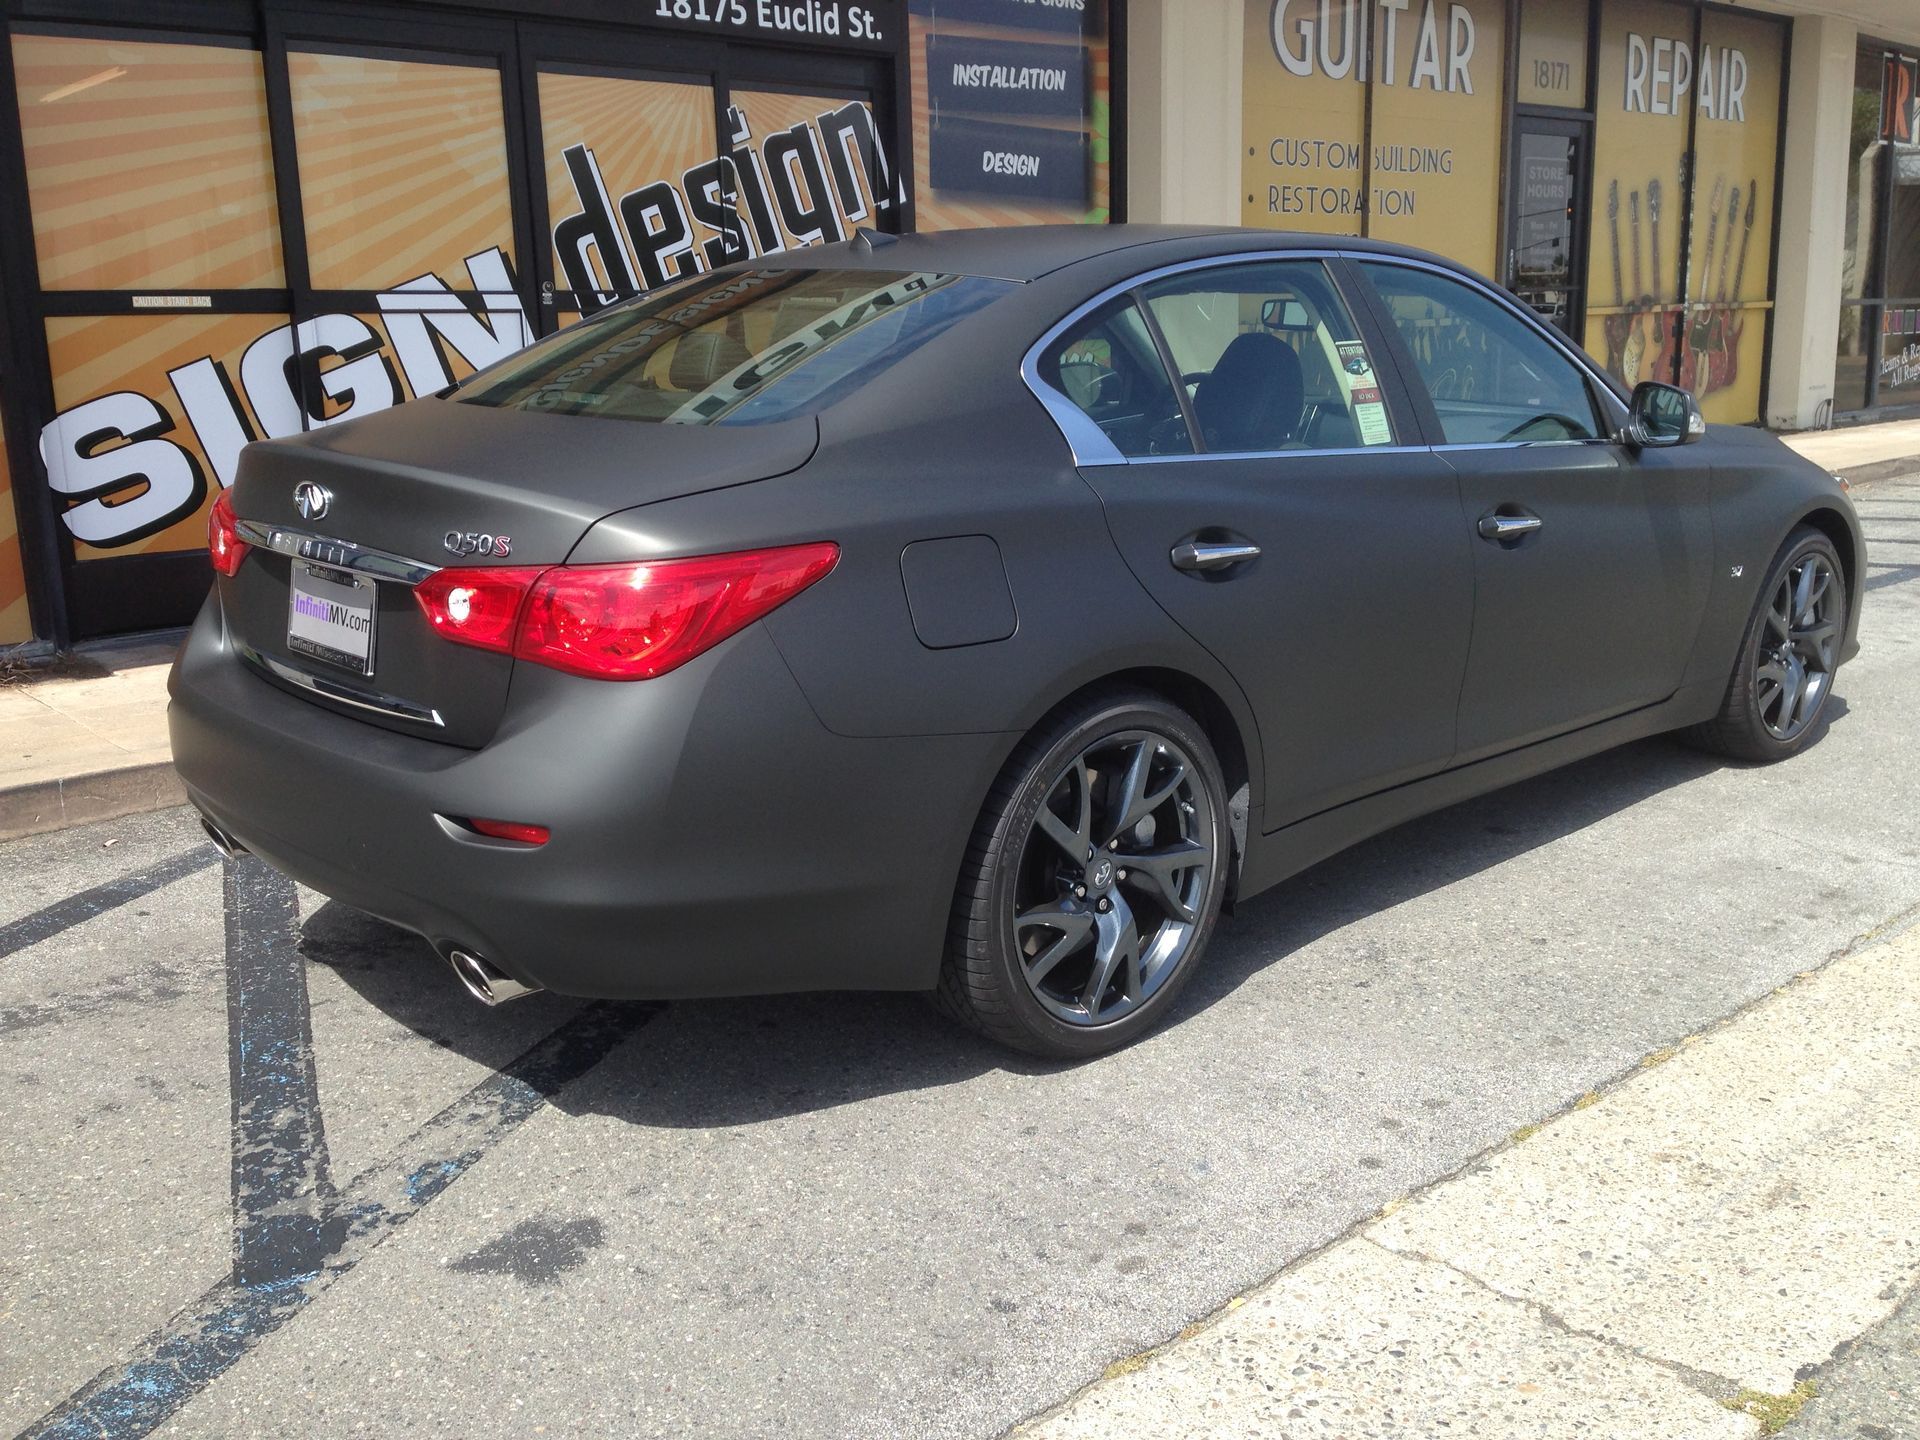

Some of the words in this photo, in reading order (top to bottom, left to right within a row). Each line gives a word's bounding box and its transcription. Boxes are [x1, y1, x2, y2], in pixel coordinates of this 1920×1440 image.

[656, 0, 747, 25] 18175
[757, 0, 840, 35] Euclid
[848, 6, 882, 40] St.
[1269, 0, 1475, 95] GUITAR
[953, 63, 1066, 91] INSTALLATION
[1534, 59, 1570, 91] 18171
[1624, 32, 1747, 122] REPAIR
[982, 150, 1040, 177] DESIGN
[1270, 138, 1360, 170] CUSTOM
[1529, 165, 1564, 181] STORE
[1268, 184, 1415, 216] RESTORAION
[1527, 183, 1565, 199] HOURS
[133, 296, 164, 307] CAUTION
[167, 296, 190, 307] STAND
[193, 296, 212, 307] BACK
[38, 246, 541, 548] SIGN
[553, 100, 907, 320] design
[443, 530, 513, 558] Q50S
[295, 594, 370, 633] InfinitiMV.com
